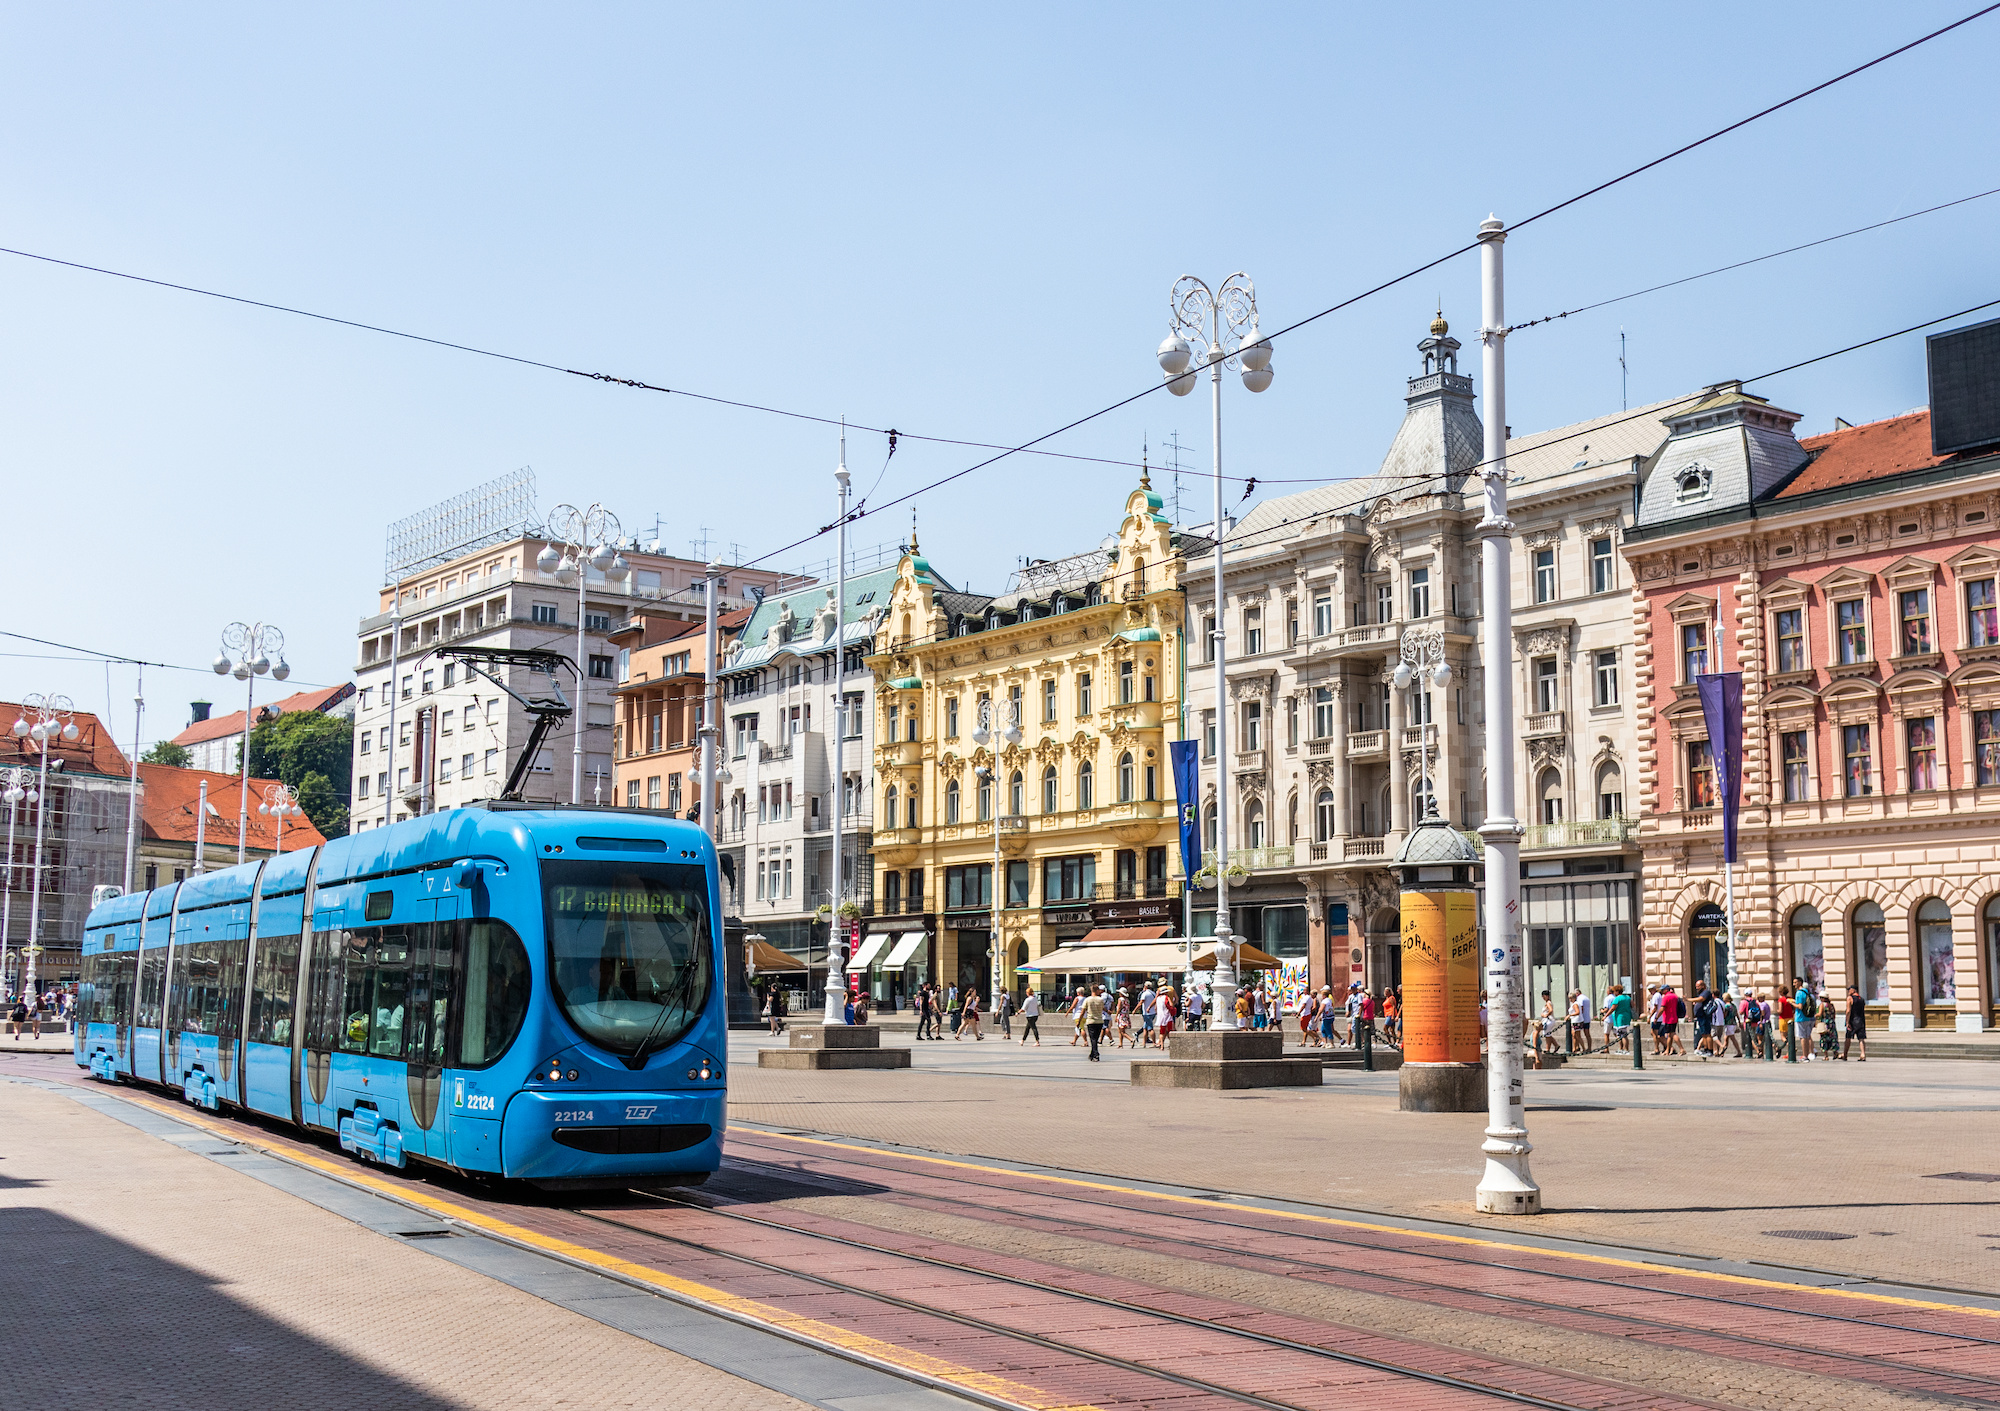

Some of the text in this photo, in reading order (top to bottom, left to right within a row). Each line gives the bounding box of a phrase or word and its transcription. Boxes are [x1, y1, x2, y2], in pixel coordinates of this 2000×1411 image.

[557, 887, 686, 914] 17 BORONGAJ
[1138, 906, 1160, 915] BASLER
[467, 1094, 494, 1110] 22124
[554, 1110, 594, 1122] 22124
[625, 1106, 657, 1119] ZET
